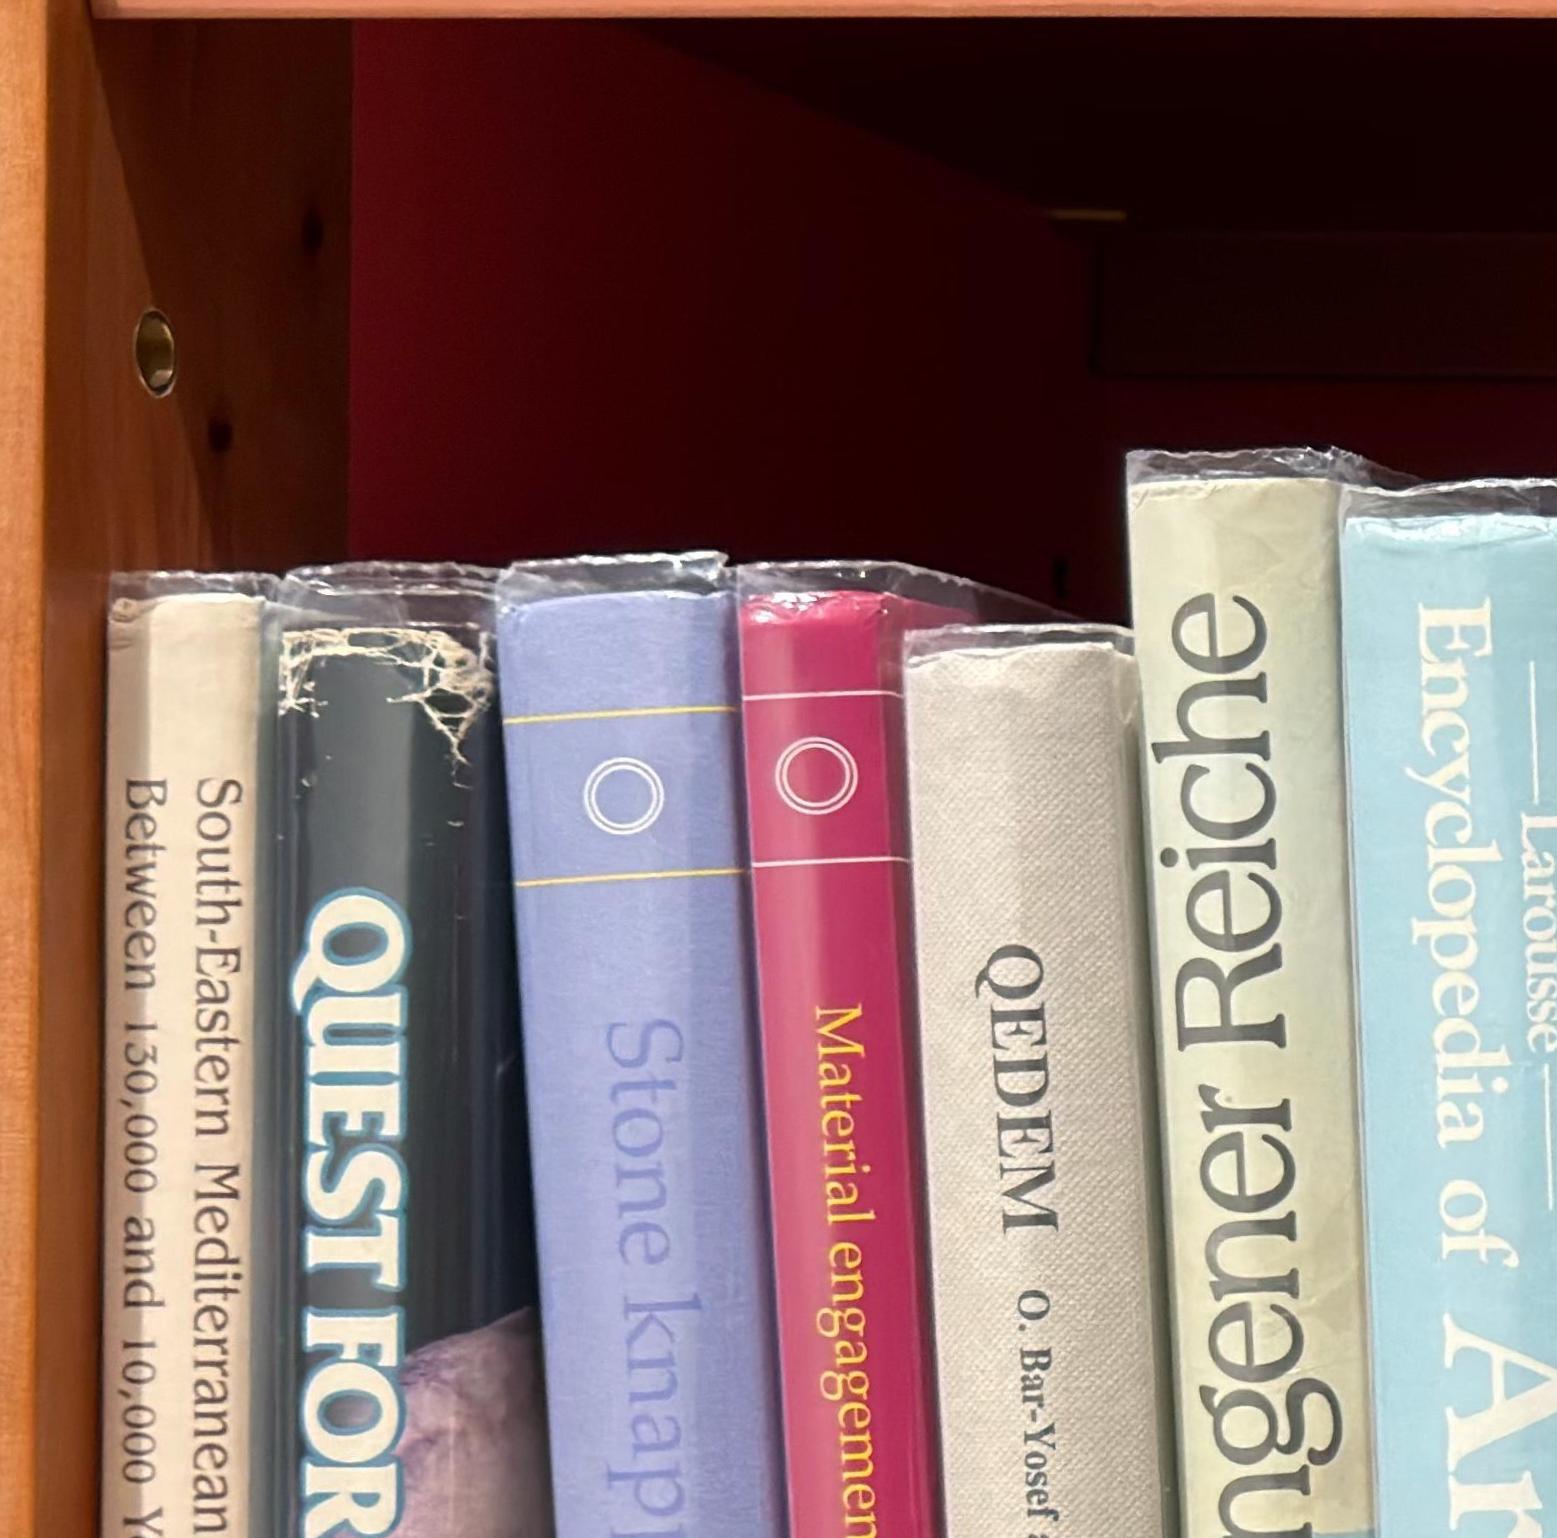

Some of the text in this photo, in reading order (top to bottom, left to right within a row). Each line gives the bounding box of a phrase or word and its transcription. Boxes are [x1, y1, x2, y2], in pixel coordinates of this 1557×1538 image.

[122, 776, 166, 992] Between
[1150, 593, 1288, 1052] Reiche
[1404, 599, 1511, 1149] Encyclopedia
[191, 776, 243, 1138] South-Eastern
[113, 1019, 159, 1194] 130,000
[289, 892, 409, 1294] QUEST
[602, 1020, 686, 1271] Stone
[813, 1001, 881, 1227] Material
[973, 943, 1060, 1236] QEDEM
[118, 1216, 166, 1309] and
[1015, 1288, 1051, 1334] O.
[1437, 1179, 1520, 1267] of
[113, 1337, 159, 1486] 10,000
[188, 1161, 243, 1535] Mediterranean
[1016, 1346, 1062, 1520] Bar-Yosef
